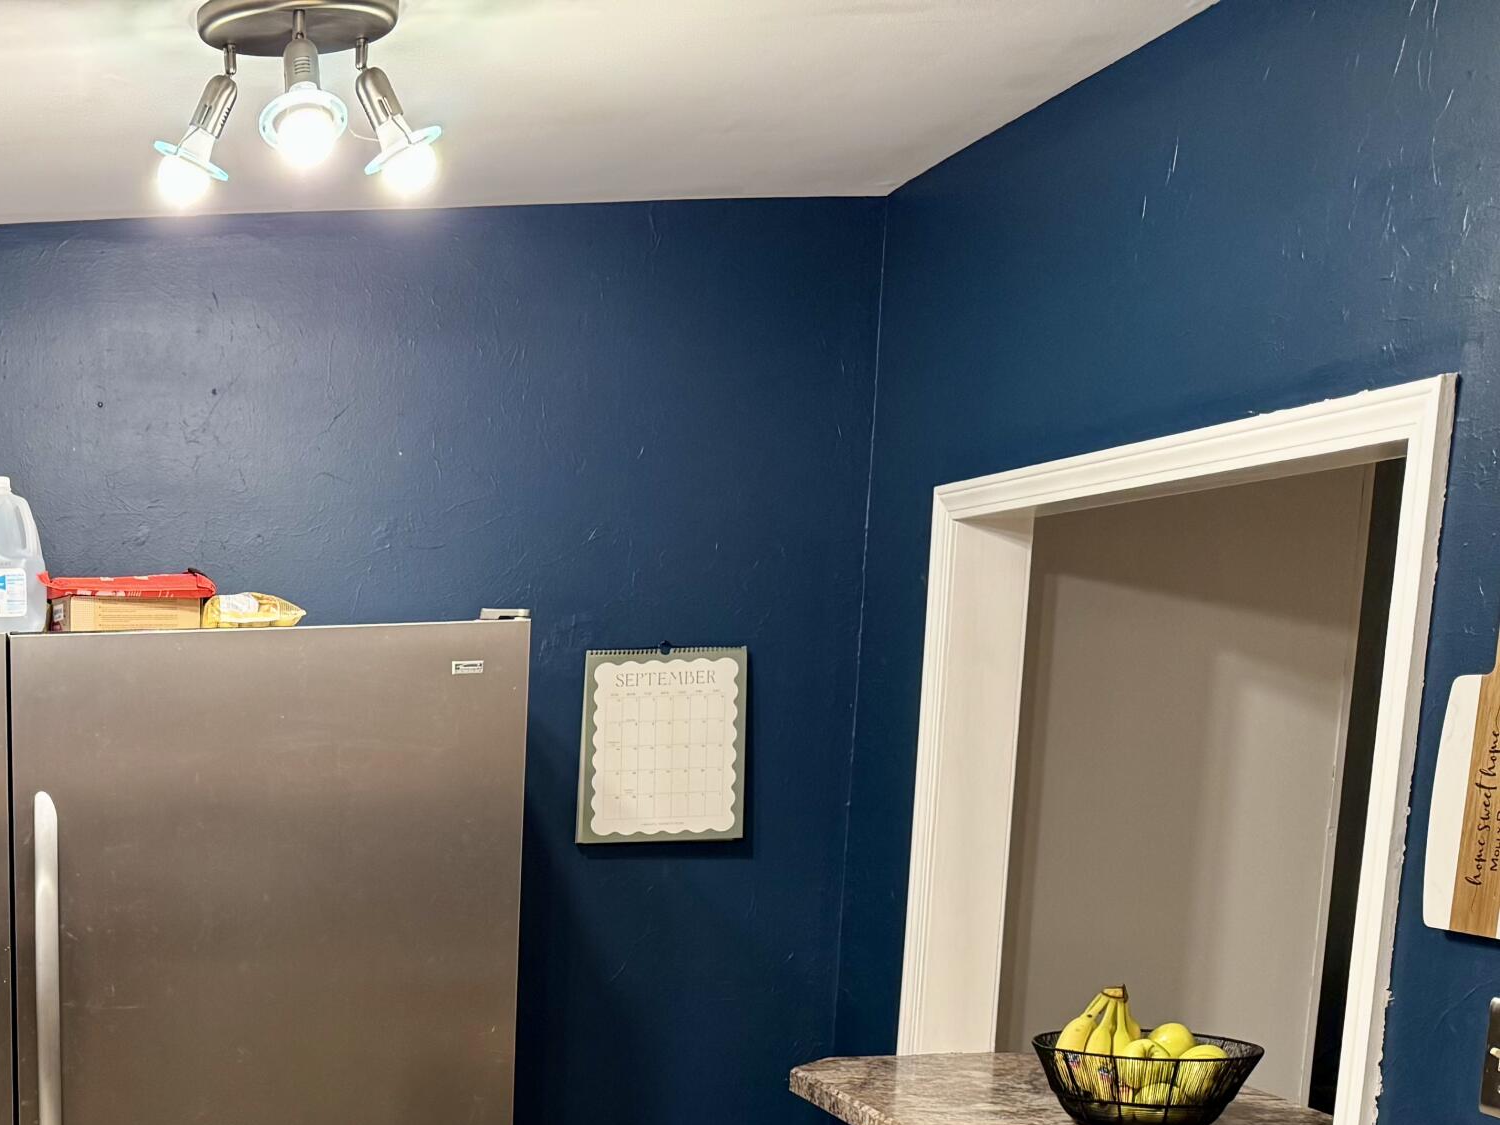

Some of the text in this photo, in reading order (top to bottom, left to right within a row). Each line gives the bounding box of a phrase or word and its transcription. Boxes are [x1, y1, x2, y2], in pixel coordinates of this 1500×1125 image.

[615, 670, 717, 688] SEPTEMBER
[1465, 730, 1500, 886] home sweet home
